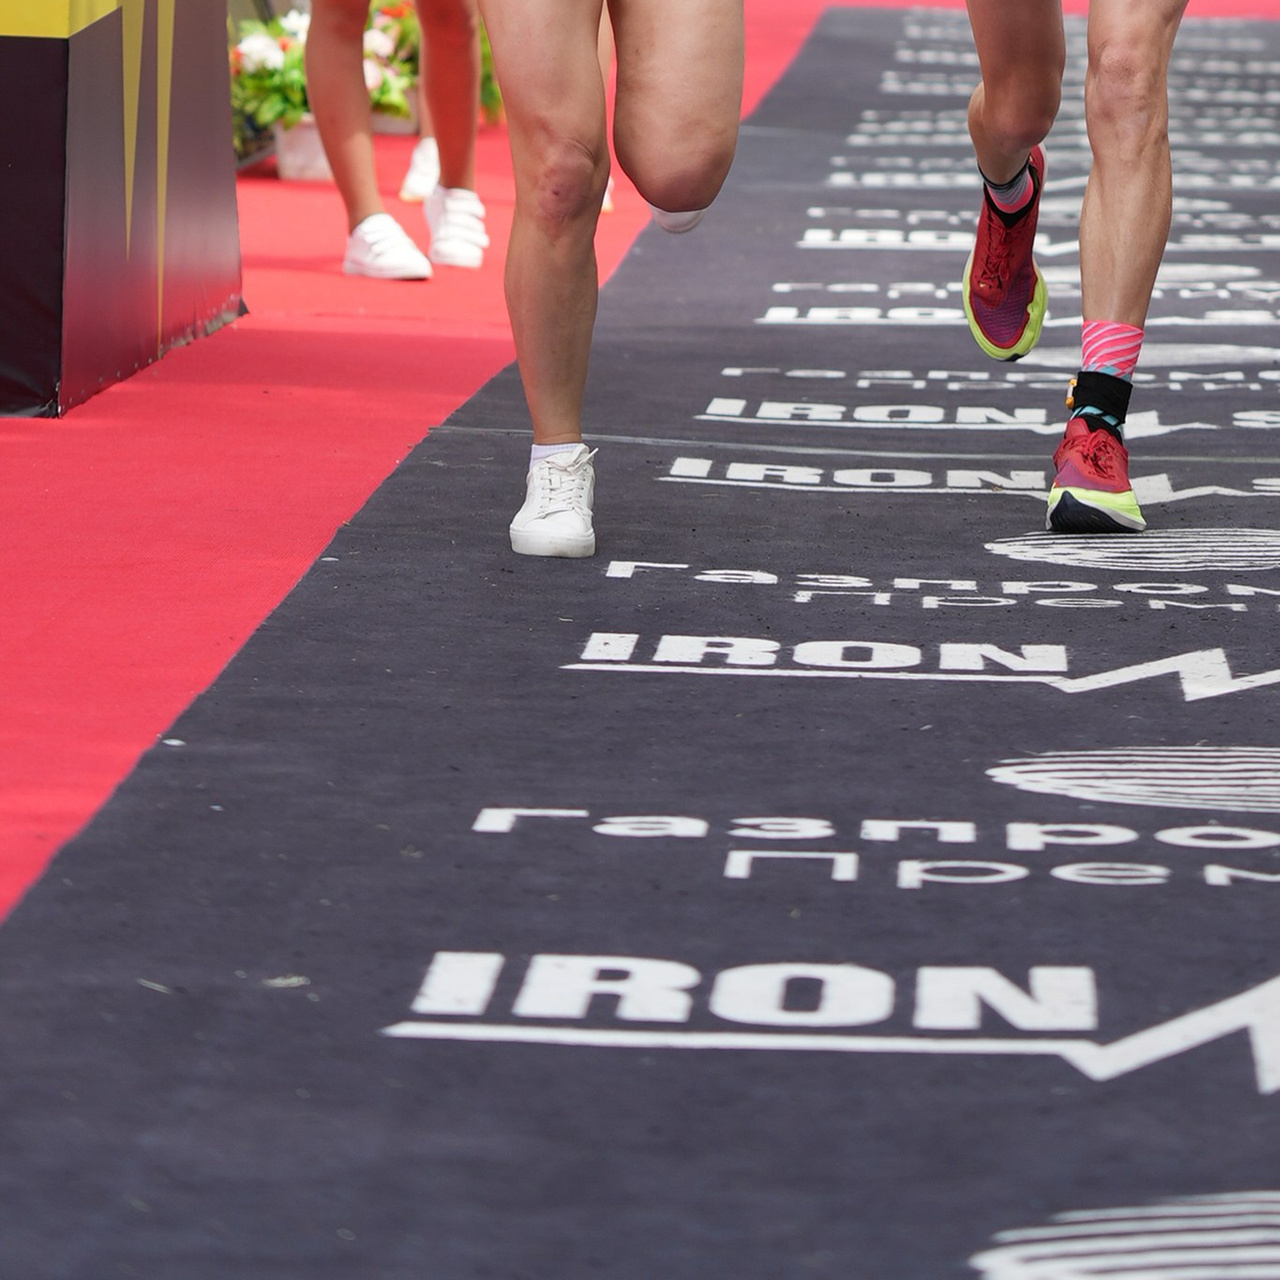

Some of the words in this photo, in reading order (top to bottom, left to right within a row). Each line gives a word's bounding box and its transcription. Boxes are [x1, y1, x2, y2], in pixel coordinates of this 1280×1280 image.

[705, 397, 1048, 424] IRON
[670, 456, 1047, 490] IRON
[580, 632, 1069, 673] IRON
[410, 951, 1099, 1032] IRON
